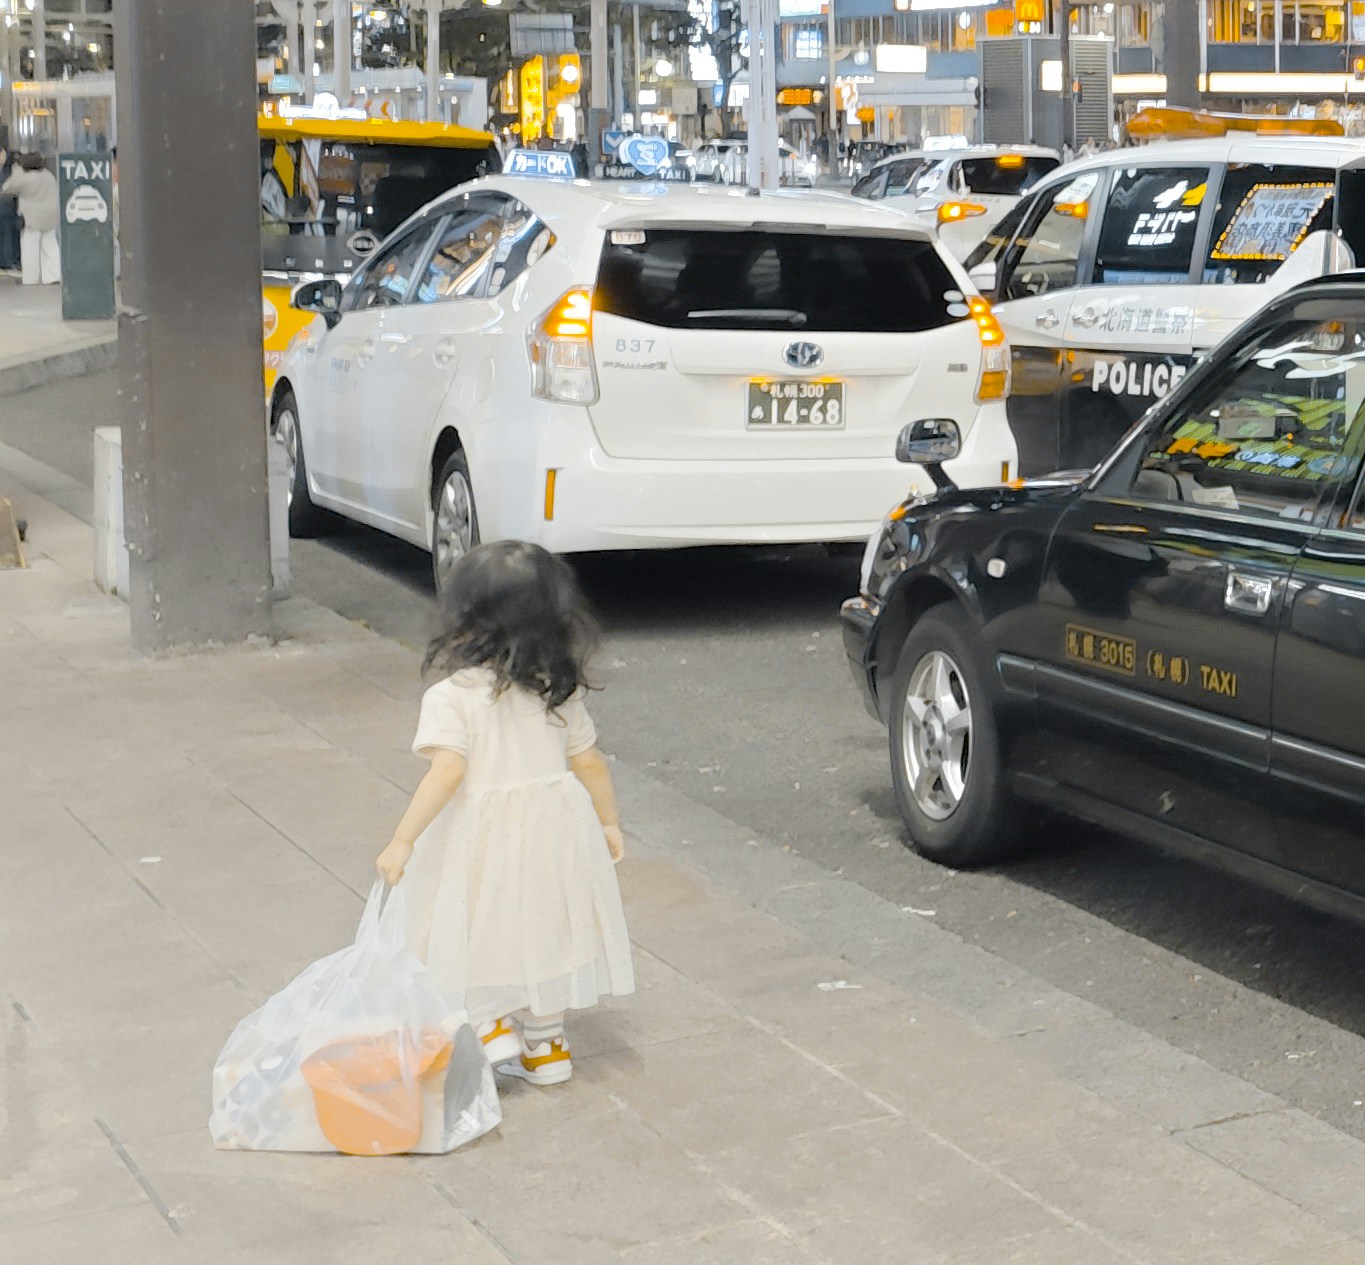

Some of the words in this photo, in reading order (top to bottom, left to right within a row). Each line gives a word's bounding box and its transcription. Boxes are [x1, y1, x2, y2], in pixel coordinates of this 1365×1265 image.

[61, 160, 110, 180] TAXI
[514, 154, 568, 174] カードOK
[658, 167, 687, 180] TAXI
[1099, 306, 1189, 335] 北海道警察
[615, 339, 656, 353] 837
[1092, 360, 1187, 398] POLICE
[770, 398, 841, 425] 14-68
[1100, 638, 1134, 669] 3015
[1200, 665, 1237, 698] TAXI
